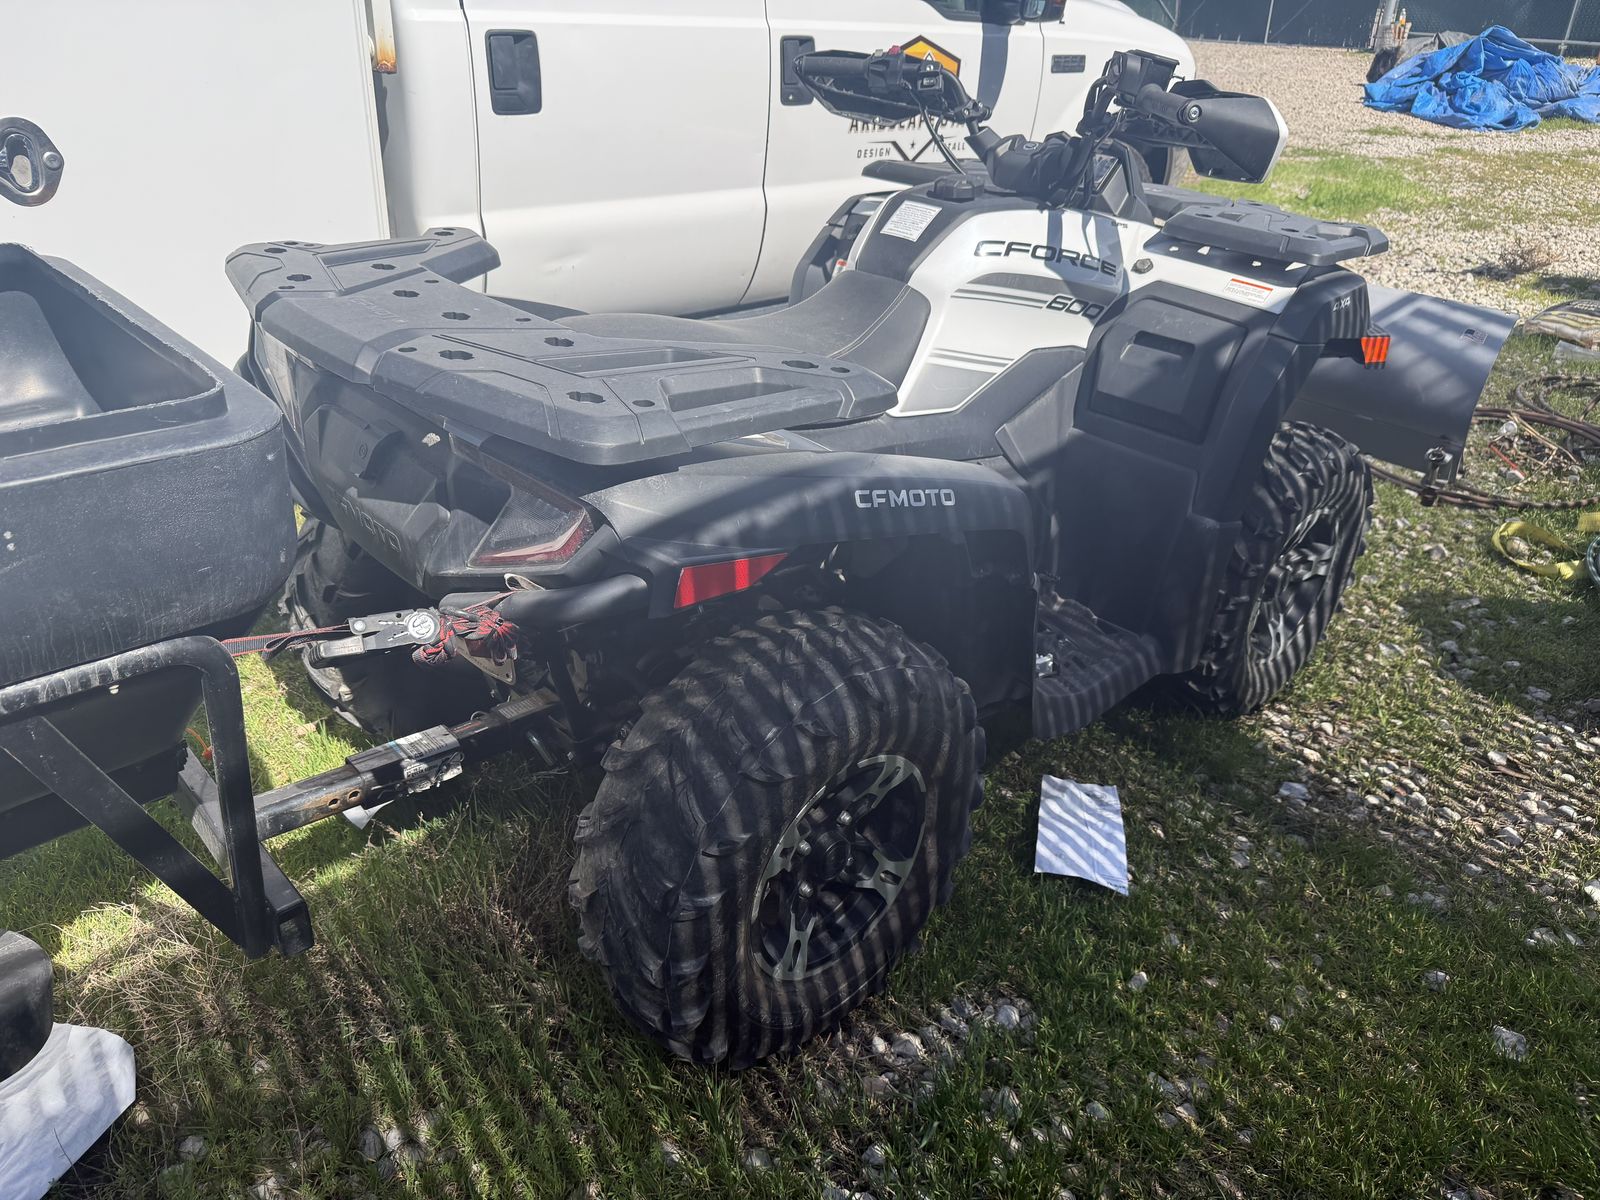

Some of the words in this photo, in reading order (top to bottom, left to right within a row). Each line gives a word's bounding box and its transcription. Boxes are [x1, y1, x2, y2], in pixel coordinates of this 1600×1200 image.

[857, 147, 891, 159] DESIGN
[974, 240, 1117, 278] CFORCE
[1045, 294, 1107, 320] 600
[854, 488, 956, 509] CFMOTO
